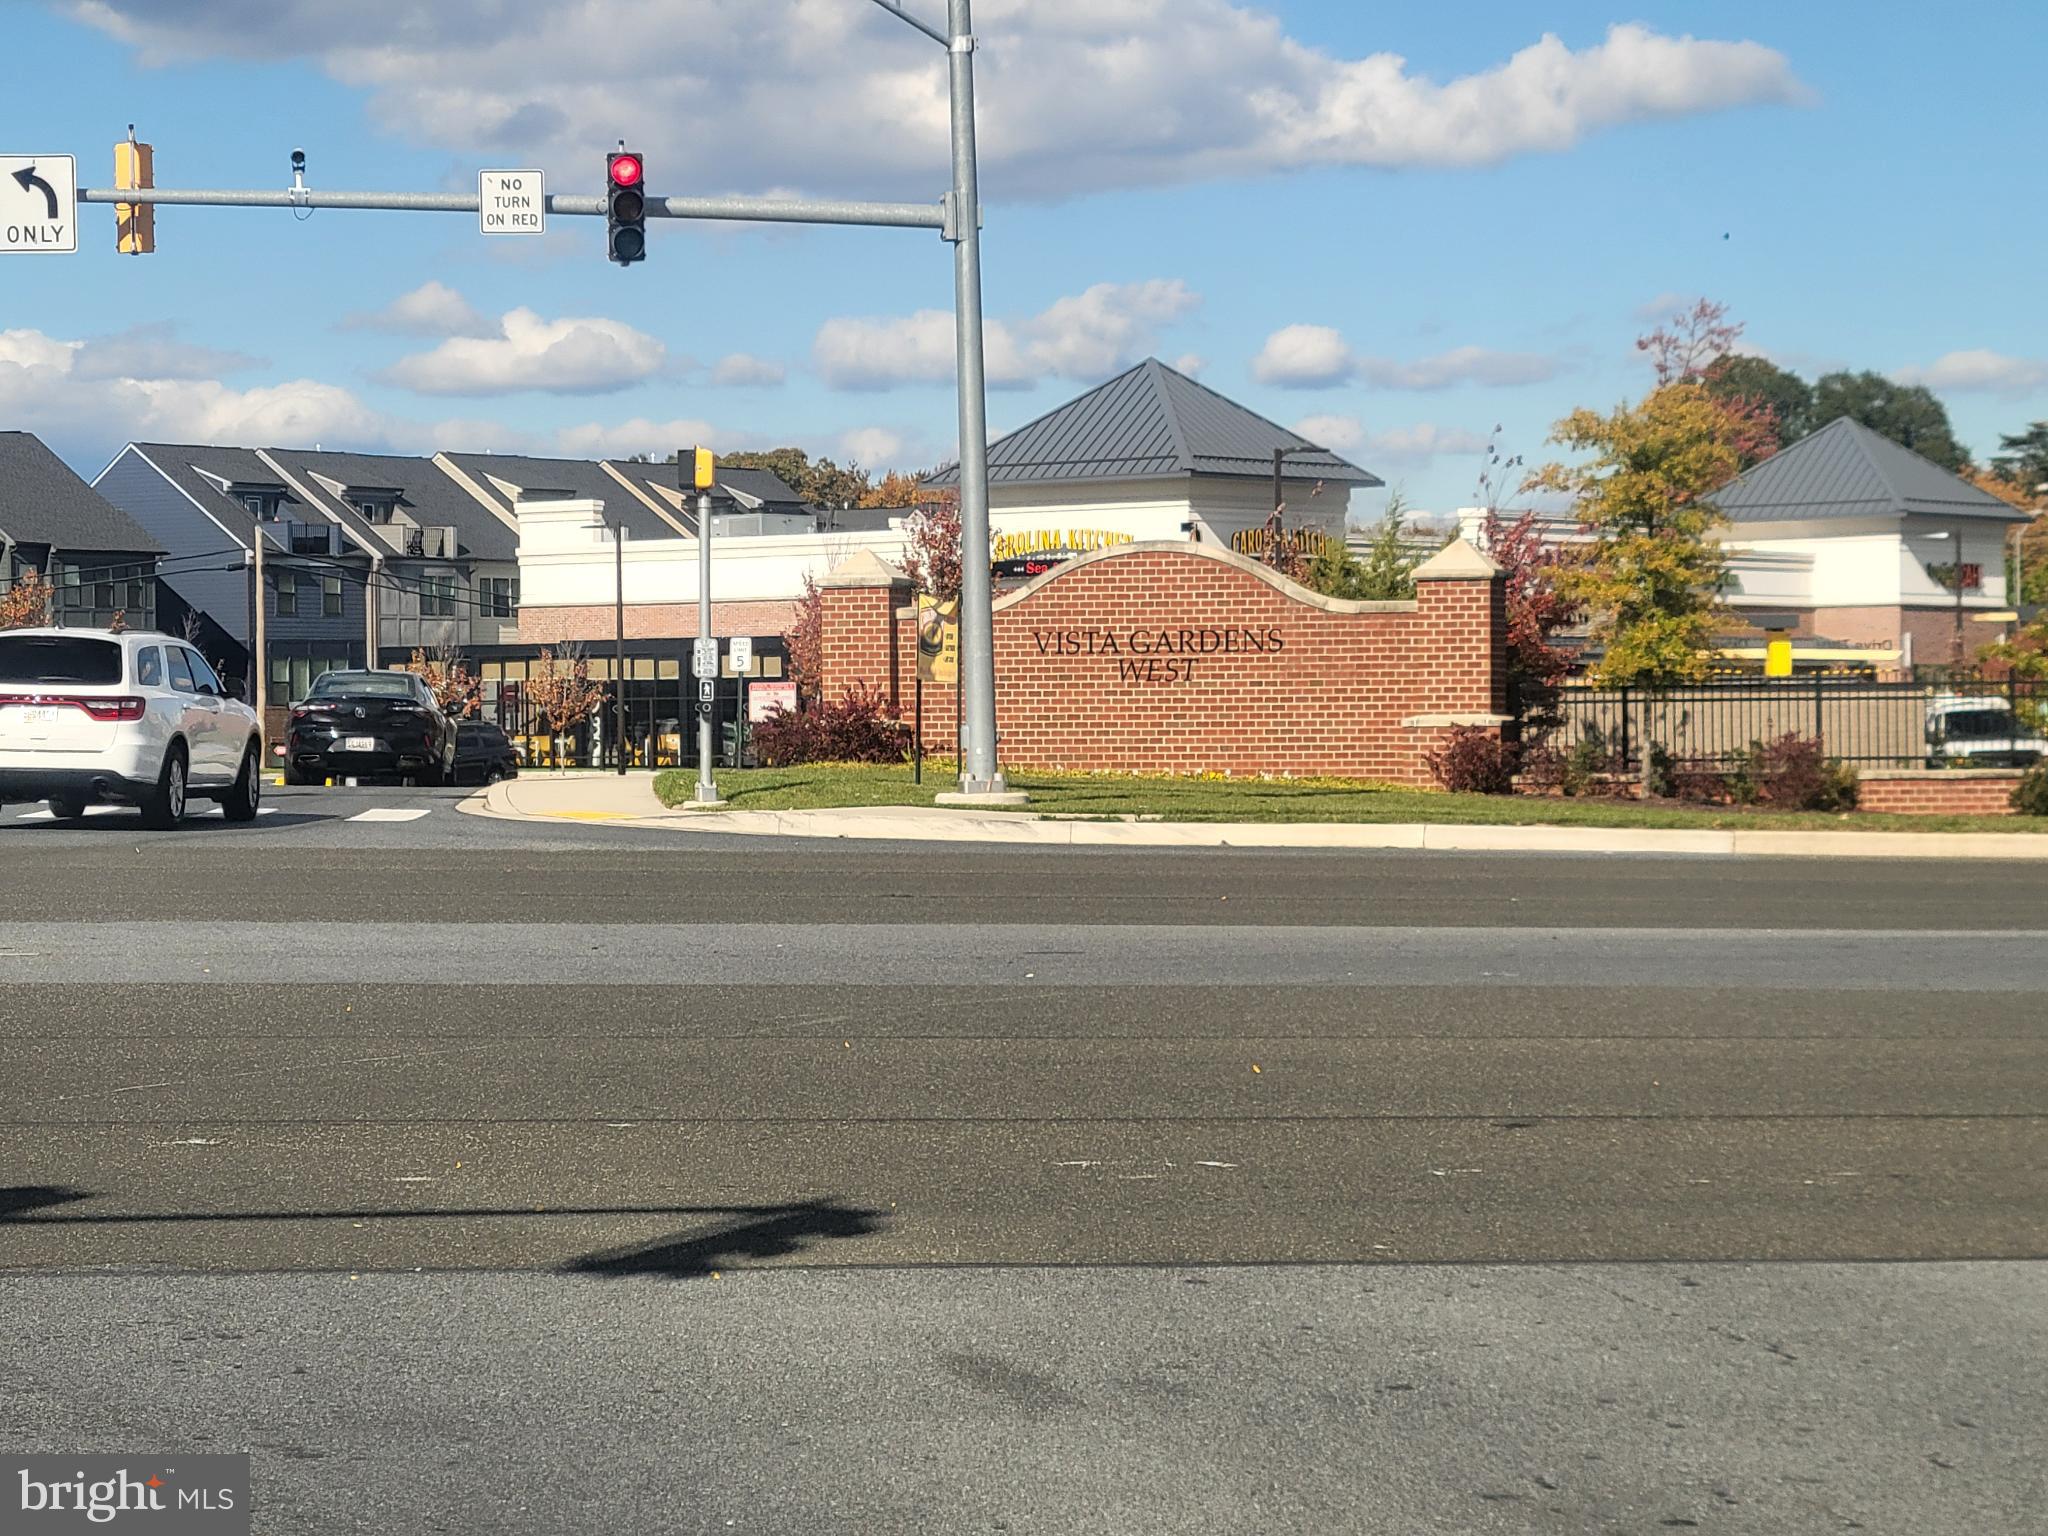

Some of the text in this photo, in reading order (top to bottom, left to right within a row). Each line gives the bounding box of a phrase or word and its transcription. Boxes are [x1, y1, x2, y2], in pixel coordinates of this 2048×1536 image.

[501, 178, 522, 190] NO
[494, 196, 530, 208] TURN
[487, 213, 538, 226] ON RED
[7, 225, 64, 243] ONLY
[991, 529, 1062, 562] AROLINA
[1231, 528, 1289, 554] CAROA
[1033, 628, 1284, 655] VISTA GARDENS
[737, 656, 744, 667] 5
[1118, 658, 1199, 682] WEST
